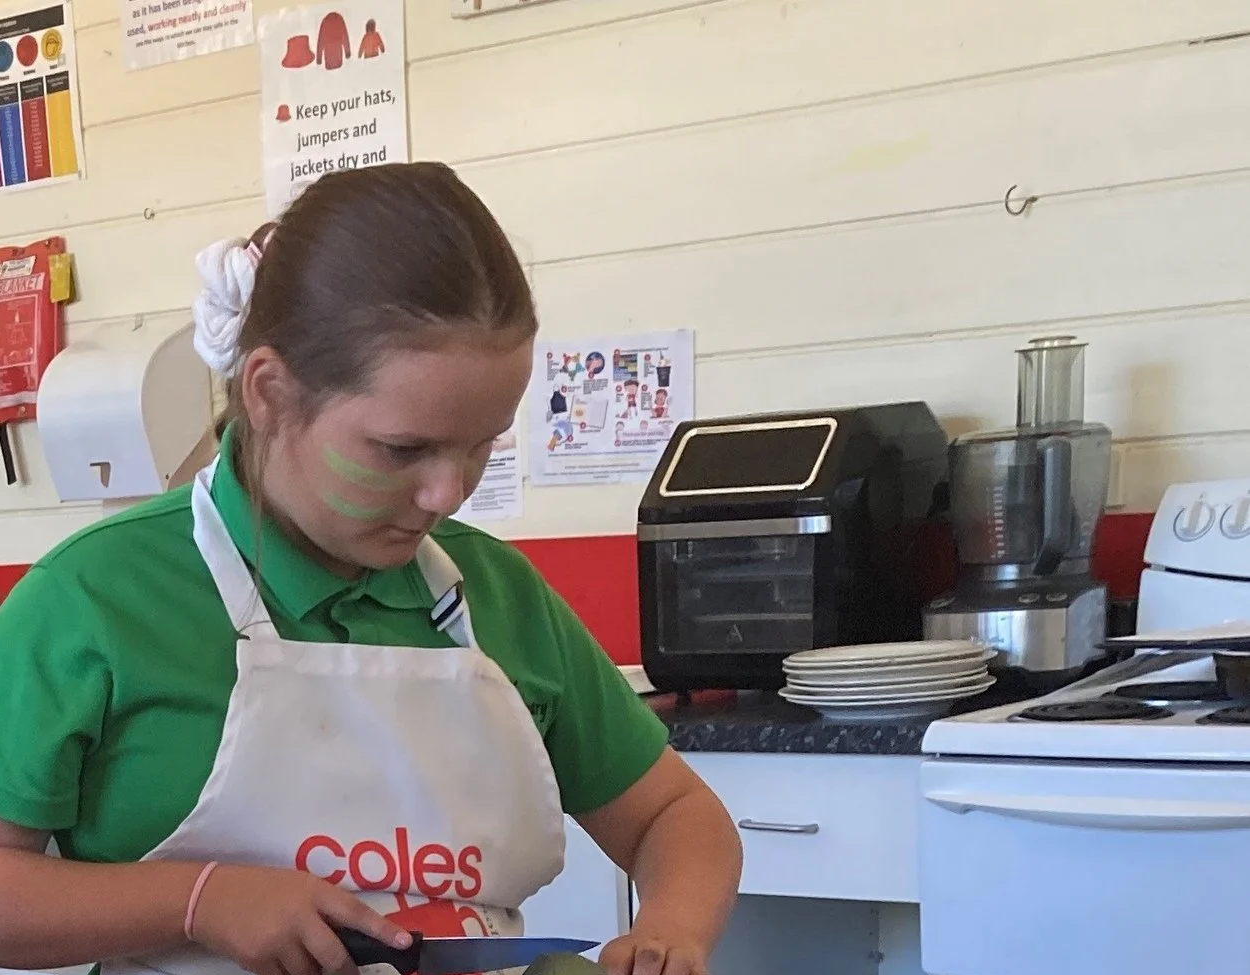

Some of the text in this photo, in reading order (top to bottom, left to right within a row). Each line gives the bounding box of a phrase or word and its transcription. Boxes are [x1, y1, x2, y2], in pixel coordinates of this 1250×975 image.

[147, 17, 177, 32] working
[203, 7, 218, 19] and
[296, 89, 396, 121] Keep your hats,
[297, 118, 377, 153] jumpers and
[290, 145, 387, 181] jackets dry and
[295, 826, 482, 898] coles
